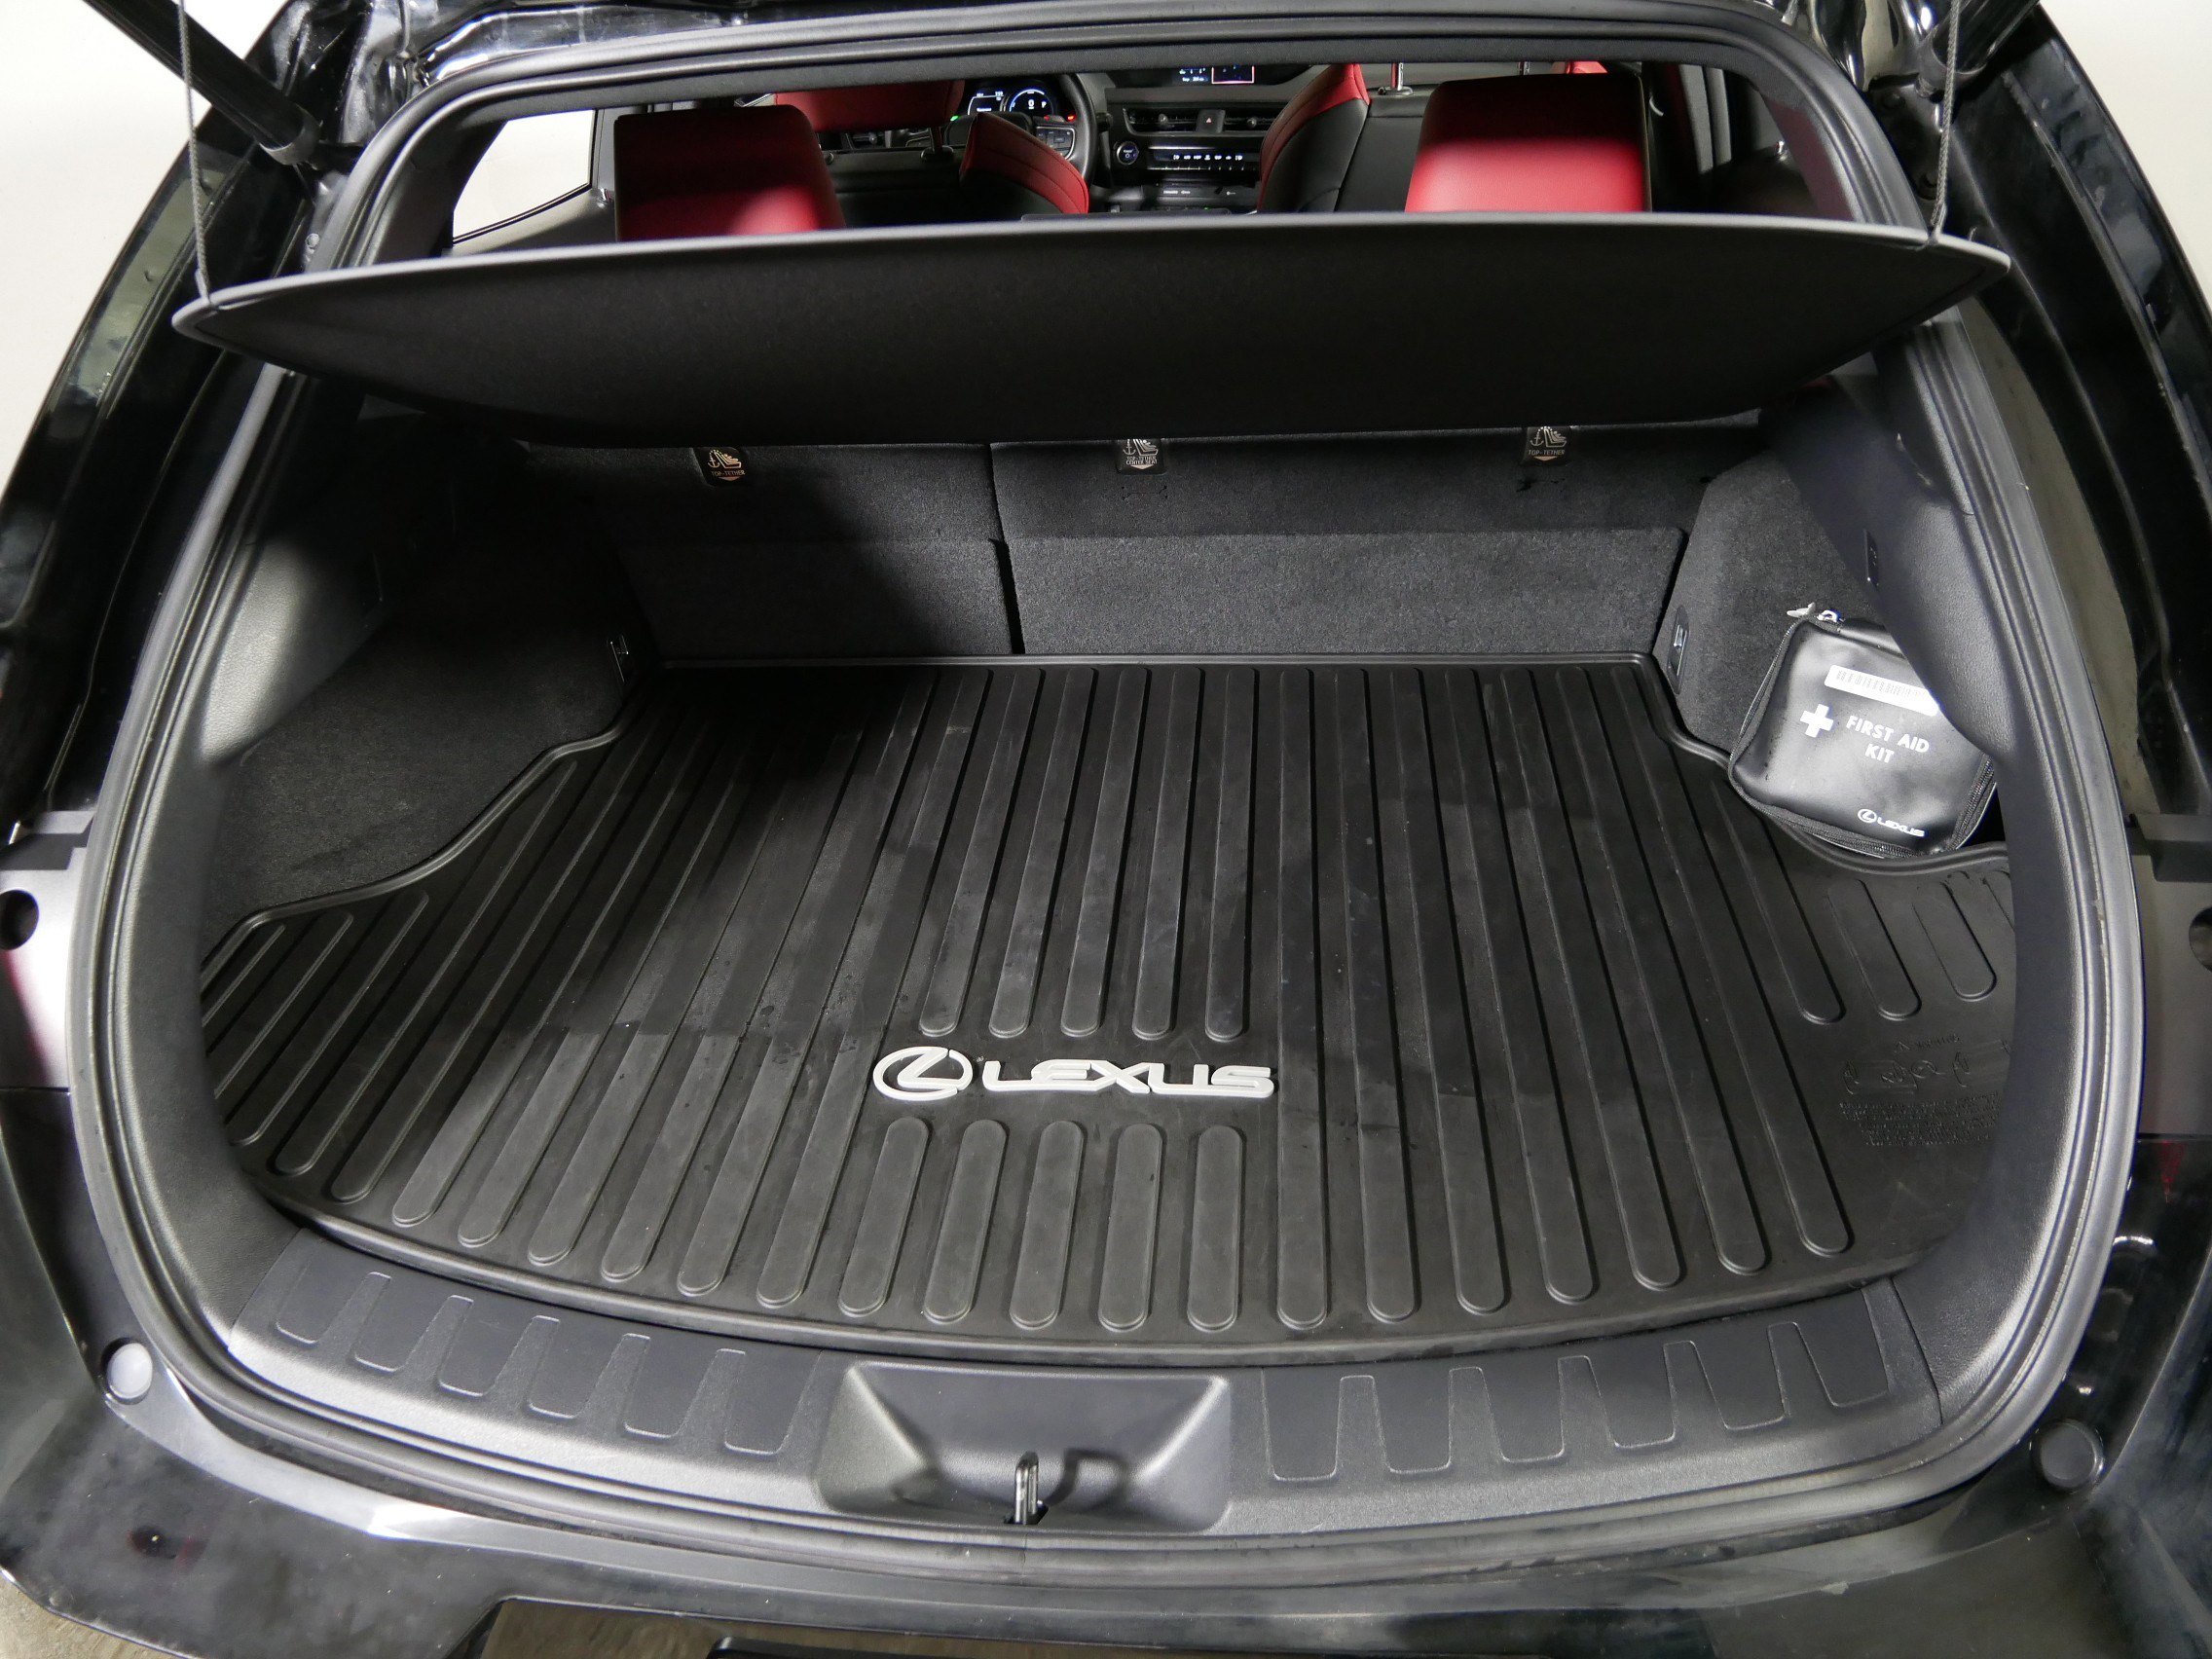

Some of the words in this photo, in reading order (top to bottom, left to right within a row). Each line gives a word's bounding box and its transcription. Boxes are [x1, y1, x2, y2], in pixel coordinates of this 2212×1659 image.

[1846, 715, 1895, 742] FIRST
[1897, 733, 1930, 753] AID
[1864, 743, 1895, 763] KIT
[1877, 816, 1926, 837] LEXUS
[981, 1058, 1274, 1099] LEXUS
